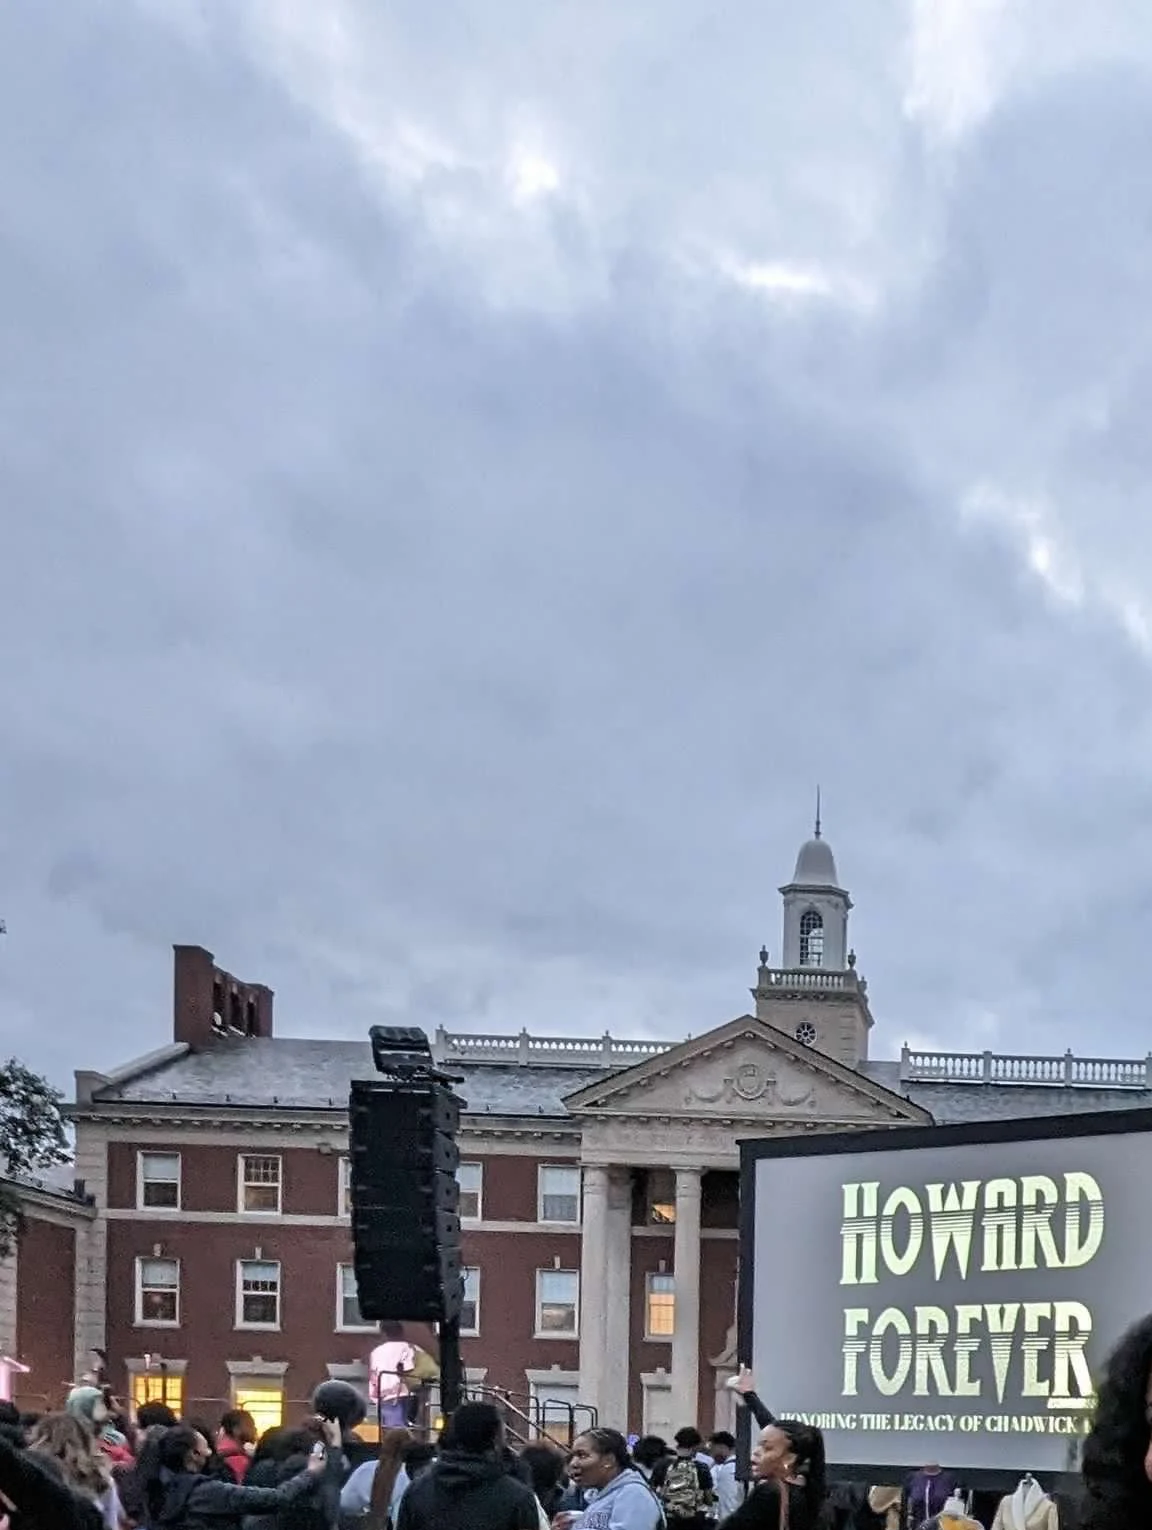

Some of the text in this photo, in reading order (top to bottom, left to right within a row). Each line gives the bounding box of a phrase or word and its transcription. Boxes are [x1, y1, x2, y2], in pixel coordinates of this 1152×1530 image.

[840, 1171, 1104, 1285] HOWARD
[841, 1301, 1096, 1406] FOREVER
[859, 1413, 891, 1430] THE
[894, 1413, 956, 1432] LEGACY
[959, 1415, 983, 1433] OF
[985, 1415, 1078, 1434] CHADWICK
